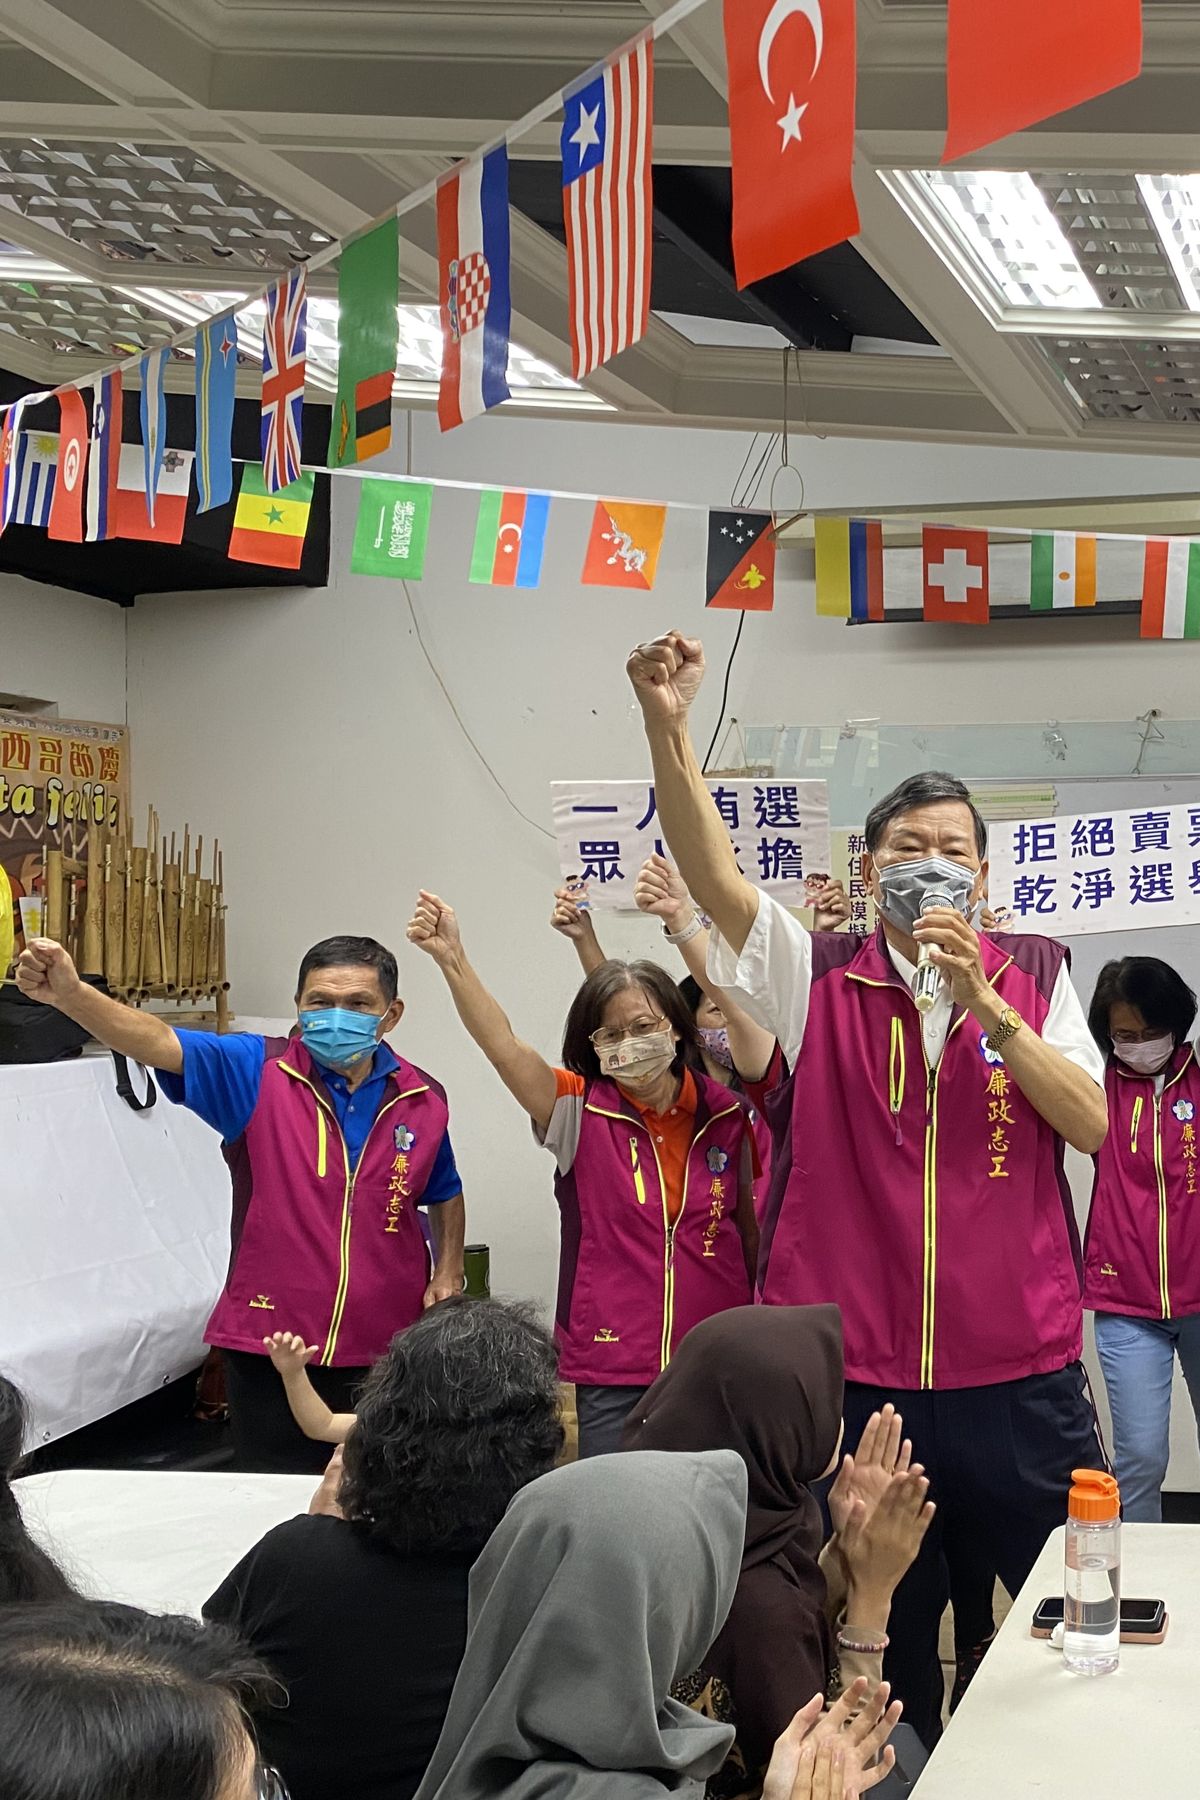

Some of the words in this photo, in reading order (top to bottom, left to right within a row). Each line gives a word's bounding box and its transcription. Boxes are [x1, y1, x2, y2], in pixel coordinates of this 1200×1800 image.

[579, 837, 803, 883] 眾擔
[985, 1068, 1016, 1178] 廉政志工
[1181, 1123, 1198, 1194] 廉政志工
[384, 1153, 412, 1233] 廉政志工
[702, 1177, 725, 1257] 廉政志工
